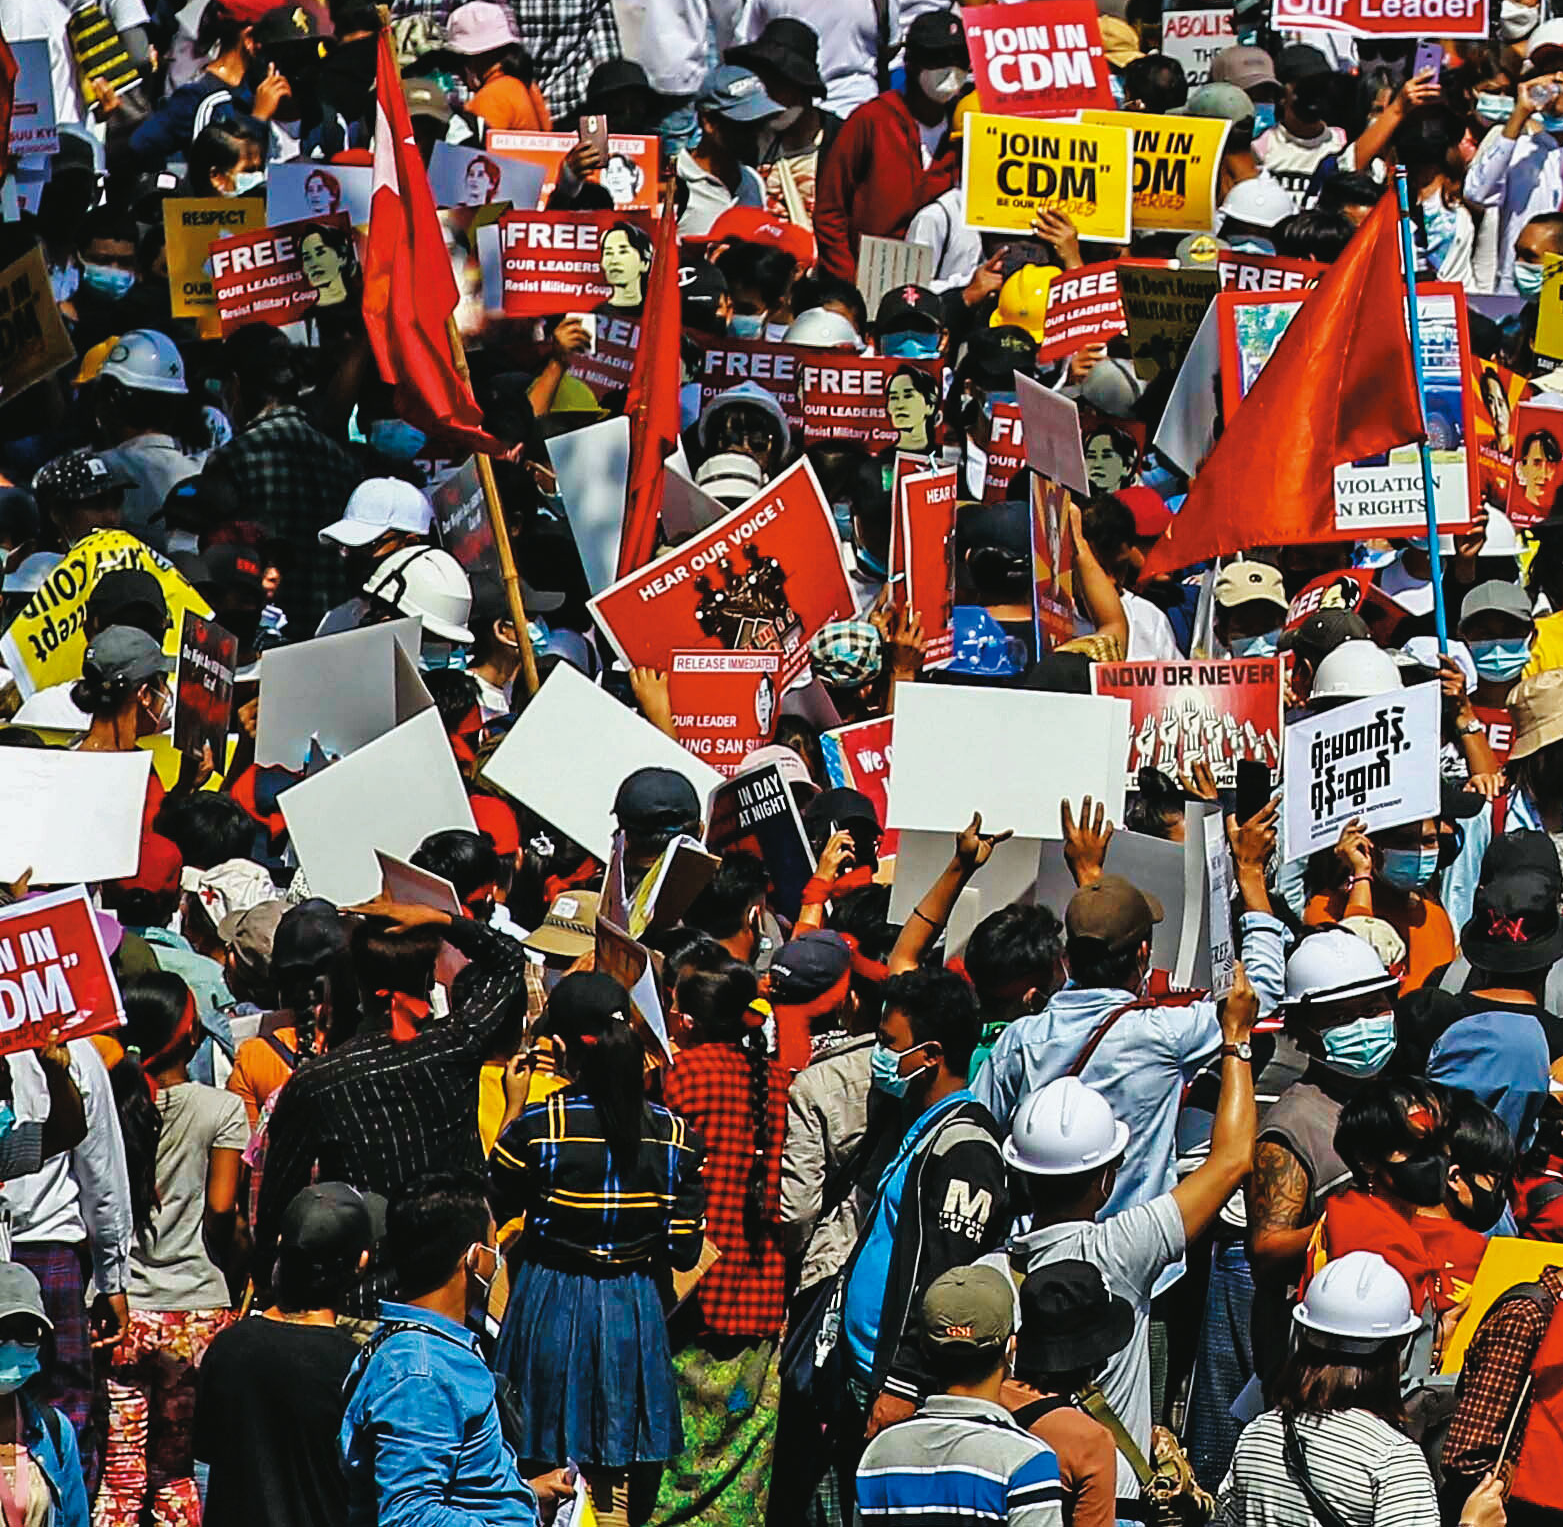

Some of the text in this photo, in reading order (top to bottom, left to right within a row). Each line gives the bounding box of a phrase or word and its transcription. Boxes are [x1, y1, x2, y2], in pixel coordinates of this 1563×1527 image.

[1055, 22, 1086, 50] IN
[1068, 137, 1099, 164] IN
[1164, 130, 1195, 156] IN
[995, 158, 1112, 204] CDM”
[505, 222, 599, 252] FREE
[211, 236, 296, 279] FREE
[505, 258, 601, 274] OUR LEADERS
[504, 279, 614, 300] Resist Military Coup
[1045, 269, 1119, 309] FREE
[1219, 262, 1302, 293] FREE
[217, 283, 245, 300] OUR
[253, 295, 291, 316] Military
[802, 365, 885, 396] FREE
[803, 404, 887, 420] OUR LEADERS
[803, 424, 900, 444] Resist Military Coup
[1335, 475, 1442, 496] VIOLATION
[1356, 498, 1428, 518] RIGHTS
[638, 507, 774, 603] HEAR OUR VOICE
[675, 655, 726, 672] RELEASE
[1100, 663, 1275, 688] NOW OR NEVER
[696, 714, 738, 729] LEADER
[715, 738, 745, 755] SAN
[738, 775, 780, 805] IN DAY
[738, 795, 787, 829] AT NIGHT
[947, 1179, 993, 1224] M
